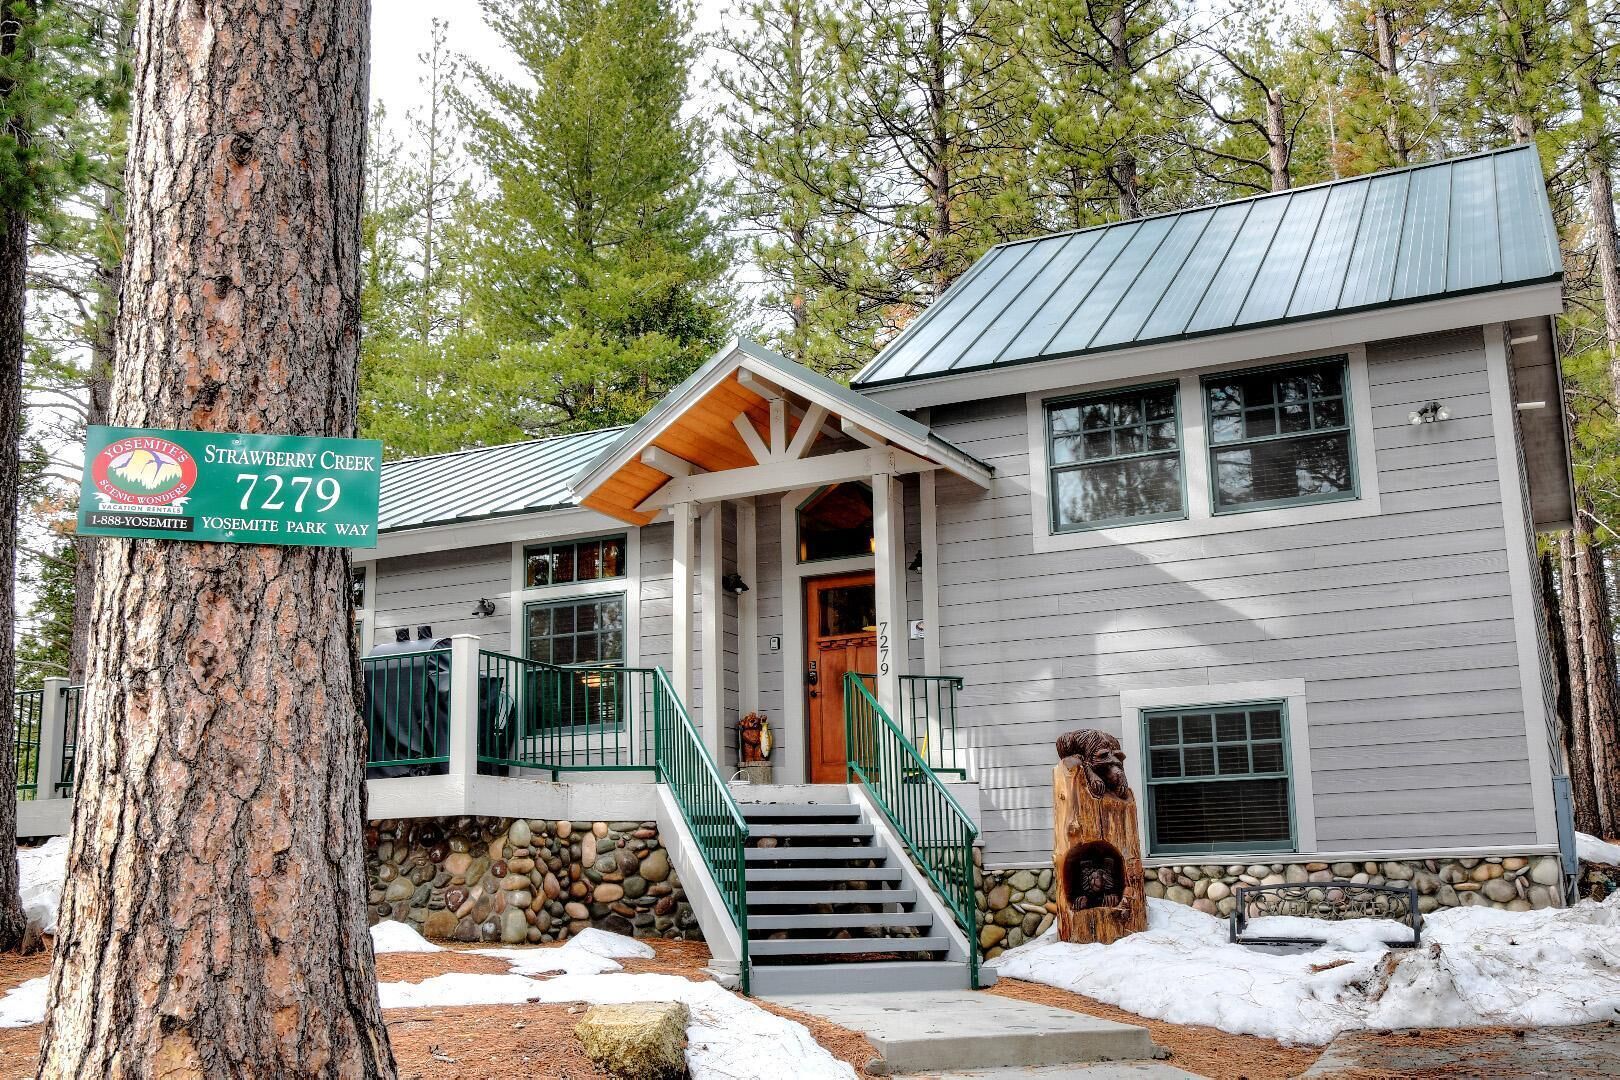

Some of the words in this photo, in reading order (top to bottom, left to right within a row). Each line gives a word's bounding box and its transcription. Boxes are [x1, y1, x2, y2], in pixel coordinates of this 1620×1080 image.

[104, 438, 189, 463] YOSEMITE'S
[204, 444, 316, 470] STRAWBERRY
[320, 450, 375, 471] CREEK
[99, 479, 135, 503] SCENIC
[137, 483, 188, 505] WONDERS
[236, 473, 341, 513] 7279
[102, 504, 143, 512] VACATION
[146, 506, 181, 514] RENTALS
[91, 515, 188, 529] 1-888-YOSEMITE
[201, 516, 278, 533] YOSEMITE
[286, 521, 326, 535] PARK
[335, 523, 370, 537] WAY
[879, 621, 889, 677] 7279
